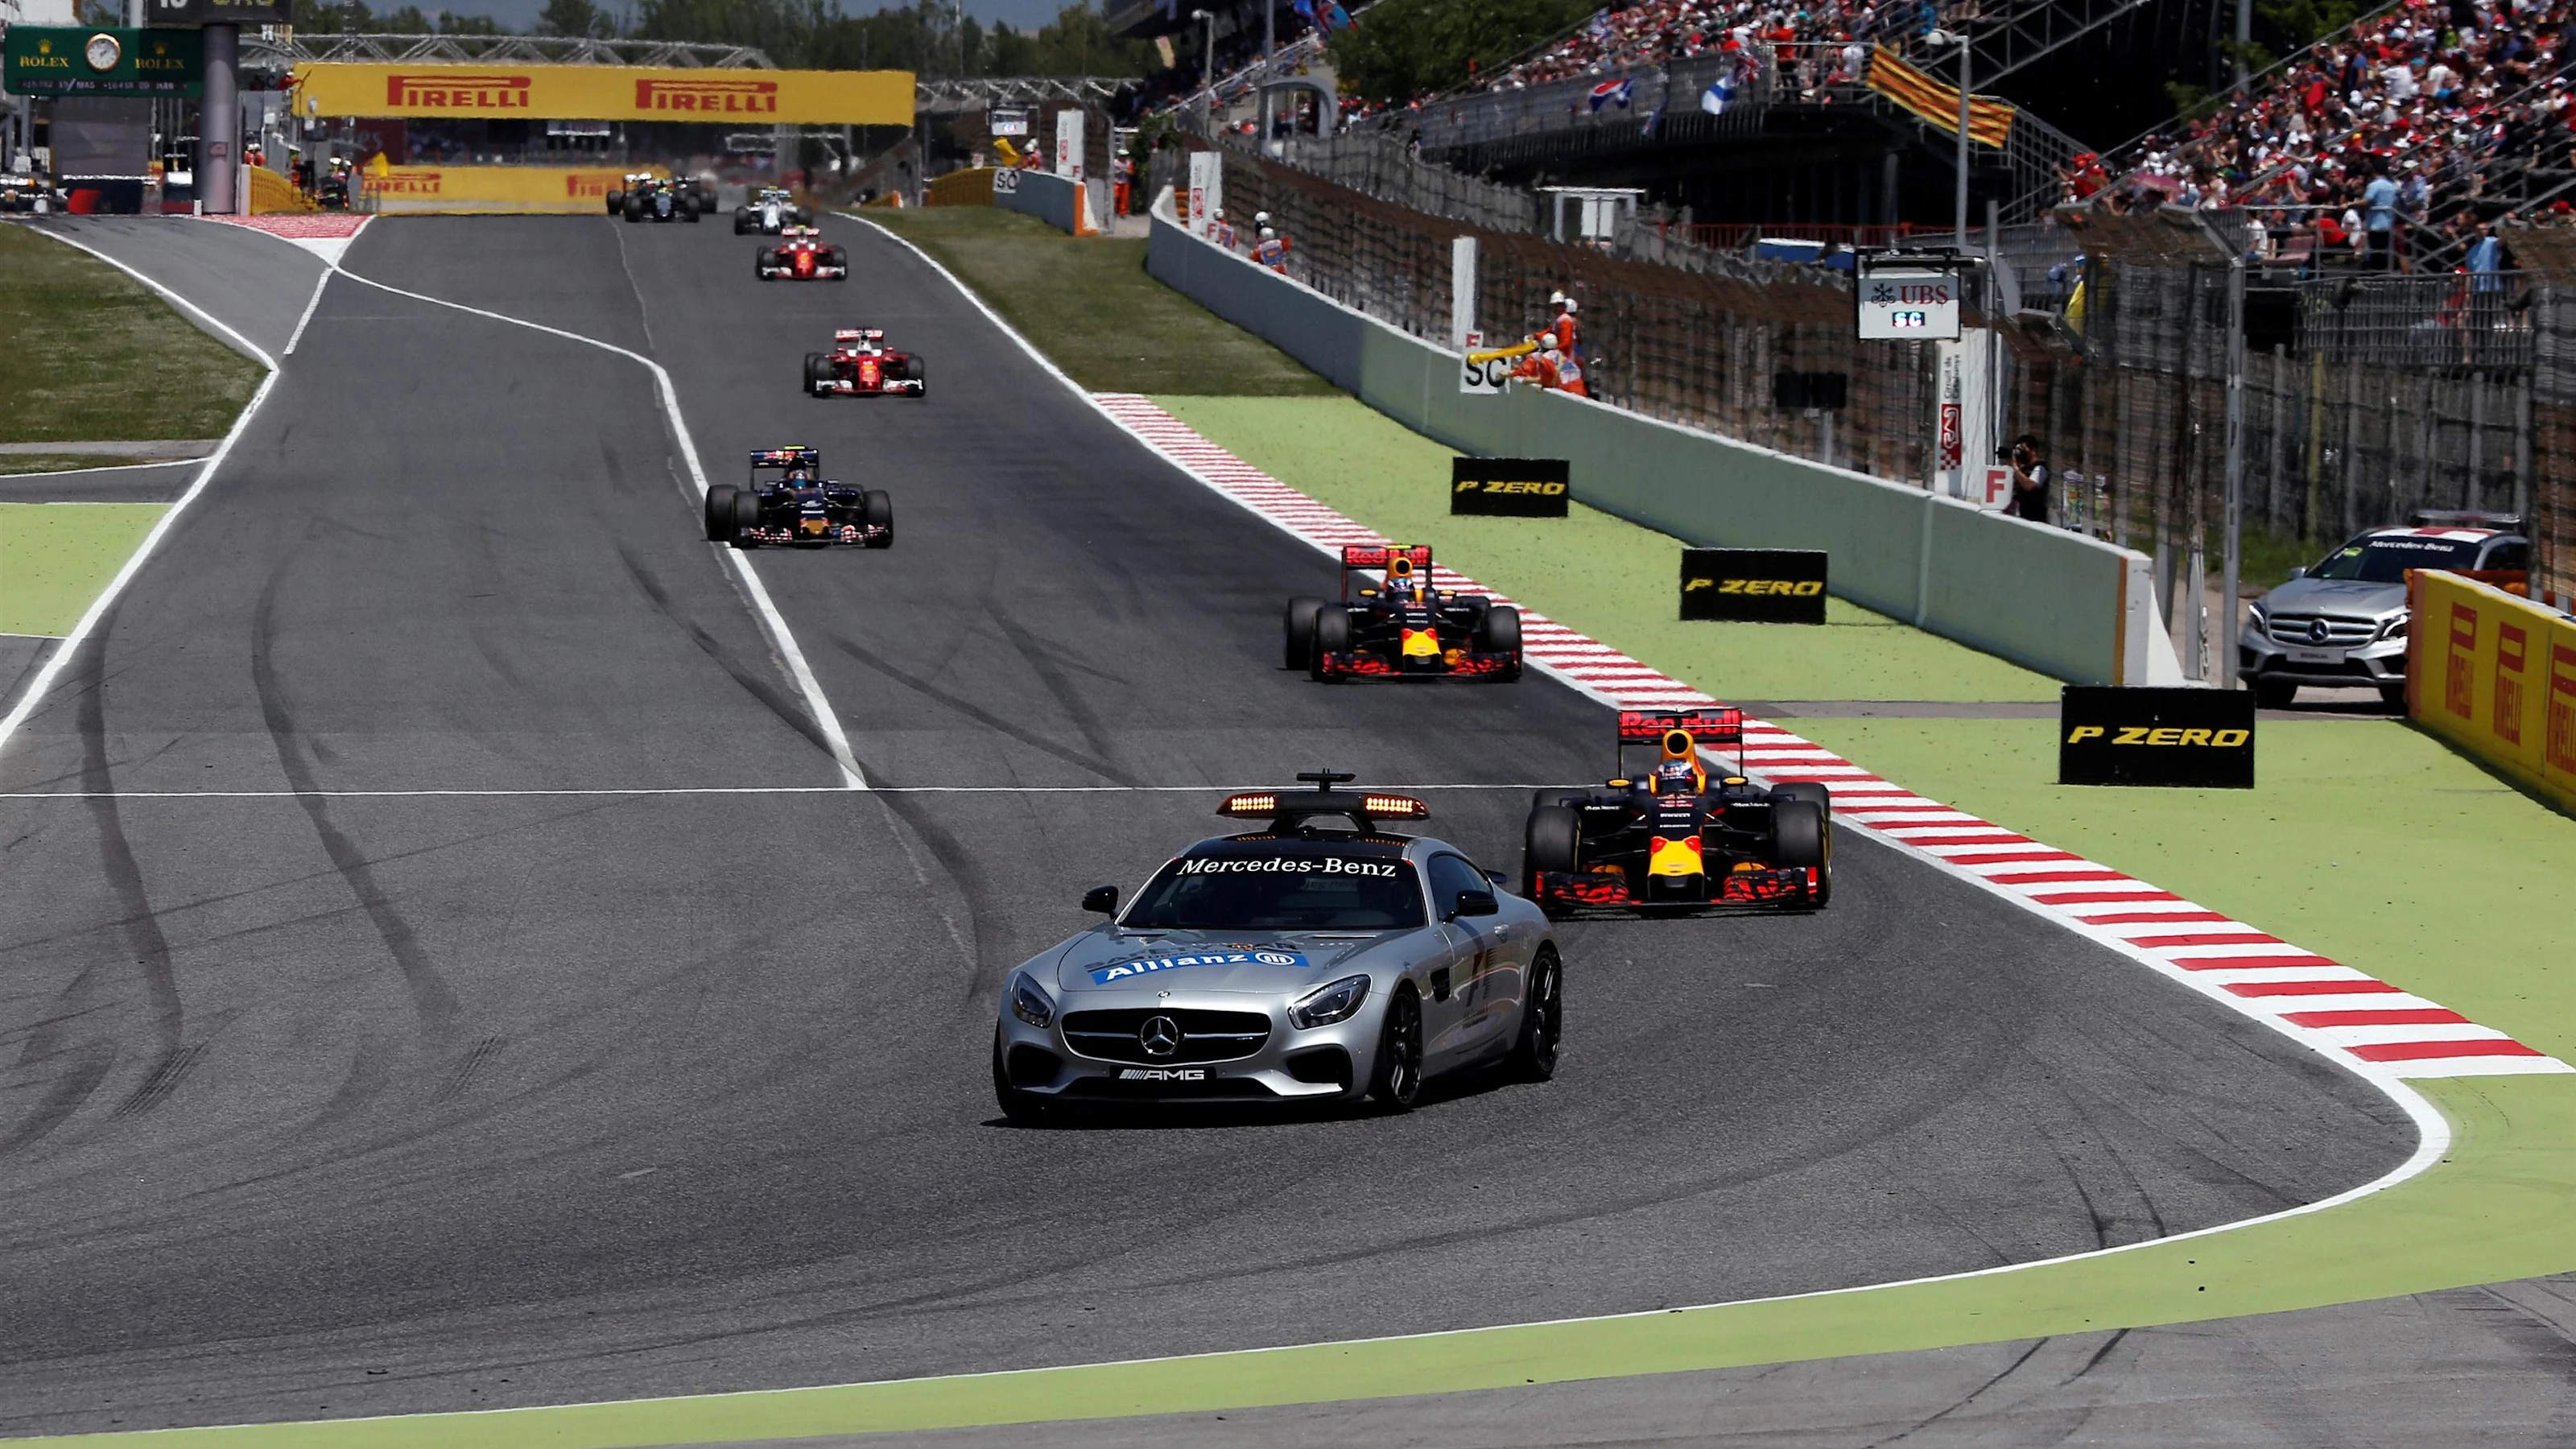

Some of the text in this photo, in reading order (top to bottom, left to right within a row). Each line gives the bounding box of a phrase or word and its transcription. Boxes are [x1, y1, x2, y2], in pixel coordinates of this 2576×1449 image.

[20, 56, 69, 67] ROLEX
[135, 58, 184, 68] ROLEX
[388, 76, 531, 107] PIRELLI
[636, 79, 777, 112] PIRELLI
[997, 173, 1018, 189] SC
[1901, 285, 1949, 304] UBS
[1894, 312, 1922, 328] SC
[1466, 333, 1480, 347] F
[1465, 357, 1507, 387] SC
[1455, 481, 1566, 495] P ZERO
[1986, 470, 2006, 503] F
[1685, 579, 1823, 596] P ZERO
[2494, 621, 2527, 746] PIRELLI
[2068, 726, 2249, 746] P ZERO
[1176, 857, 1397, 877] Mercedes-Benz
[1105, 953, 1249, 980] Allianz
[1142, 1069, 1204, 1080] AMG
